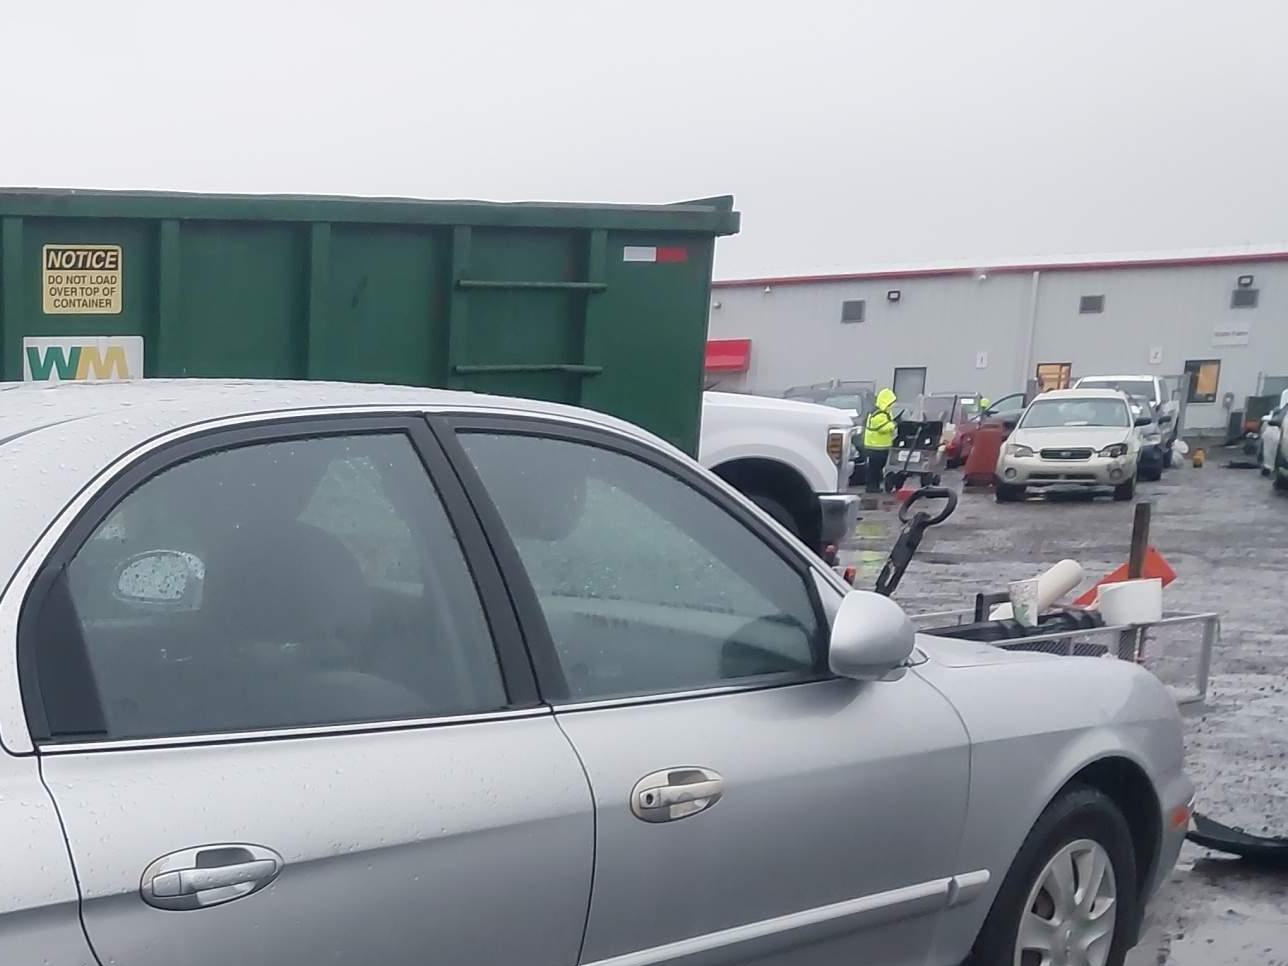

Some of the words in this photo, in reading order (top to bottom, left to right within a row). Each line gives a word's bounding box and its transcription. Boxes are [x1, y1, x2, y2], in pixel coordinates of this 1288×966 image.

[48, 251, 117, 268] NOTICE
[47, 275, 63, 285] DO
[65, 275, 88, 285] NOT
[90, 275, 118, 285] LOAD
[49, 287, 78, 297] OVER
[79, 287, 100, 297] TOP
[102, 287, 117, 297] OF
[53, 298, 113, 309] CONTAINER
[26, 346, 129, 380] WM
